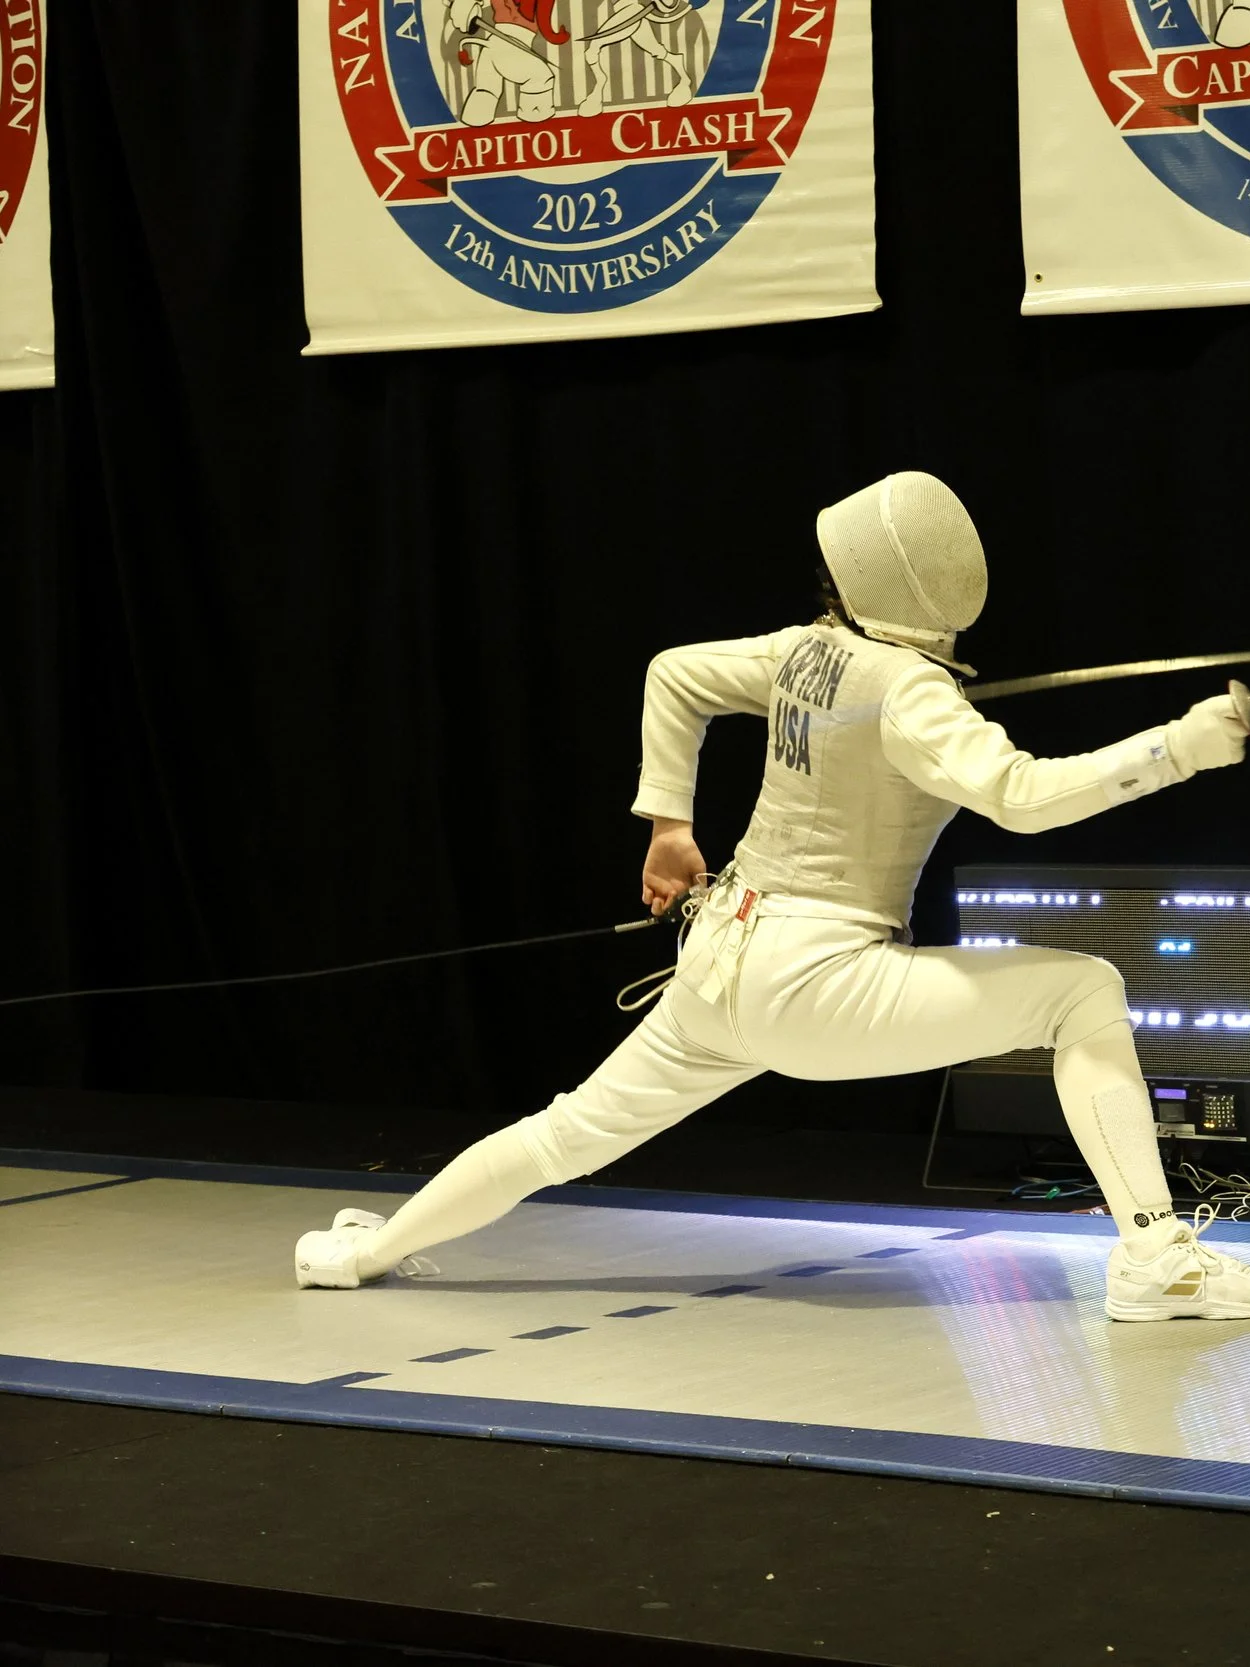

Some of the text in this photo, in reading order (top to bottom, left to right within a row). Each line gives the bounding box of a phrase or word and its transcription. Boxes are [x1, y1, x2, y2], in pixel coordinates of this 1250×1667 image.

[5, 0, 36, 135] TION
[338, 0, 375, 95] NA
[418, 112, 756, 172] CAPITOL CLASH
[443, 200, 722, 294] 12th ANNIVERSARY
[533, 187, 623, 233] 2023
[775, 697, 812, 776] USA
